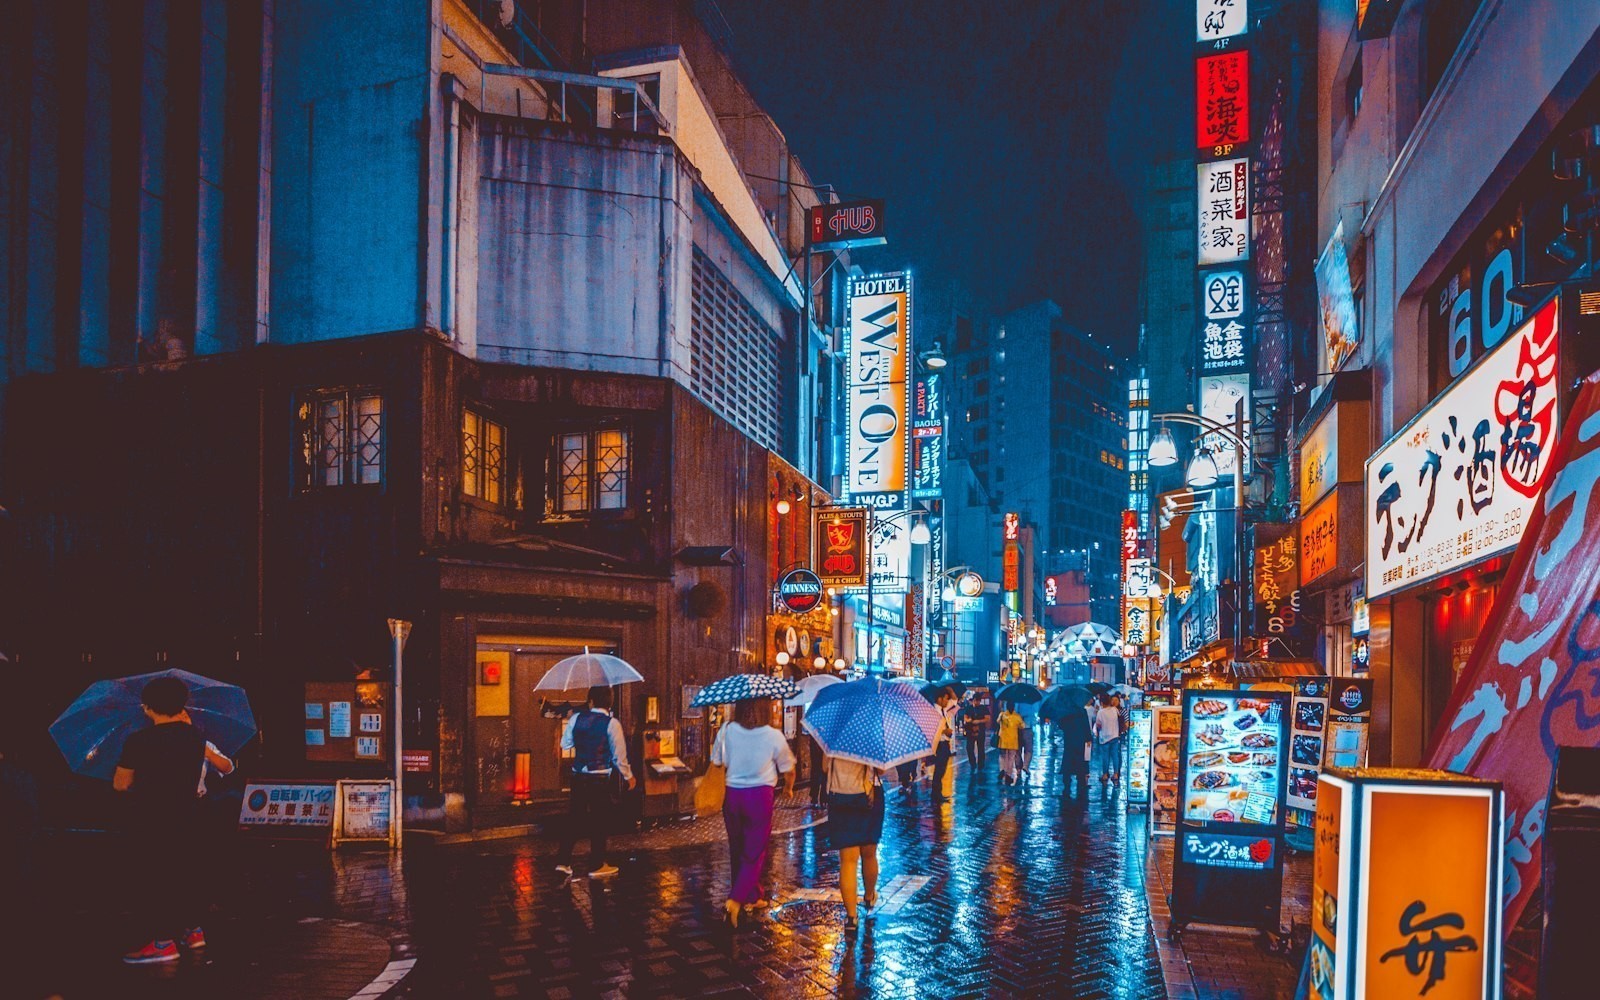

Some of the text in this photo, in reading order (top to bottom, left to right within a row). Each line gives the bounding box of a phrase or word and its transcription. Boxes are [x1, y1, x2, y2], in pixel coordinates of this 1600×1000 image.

[1213, 38, 1230, 49] 4F
[1214, 144, 1234, 156] 3F
[1209, 170, 1234, 248] 酒菜家
[828, 205, 876, 237] HUB
[1236, 233, 1246, 257] 2F
[853, 278, 905, 297] HOTEL
[914, 420, 941, 428] BAGUS
[931, 437, 940, 488] インターネット
[823, 554, 856, 575] HUB
[781, 582, 819, 595] GUINNESS
[1127, 606, 1145, 645] 金の蔵
[270, 789, 332, 803] 自転車・バイク
[268, 803, 330, 817] 放置禁止
[1187, 834, 1251, 861] テング酒場
